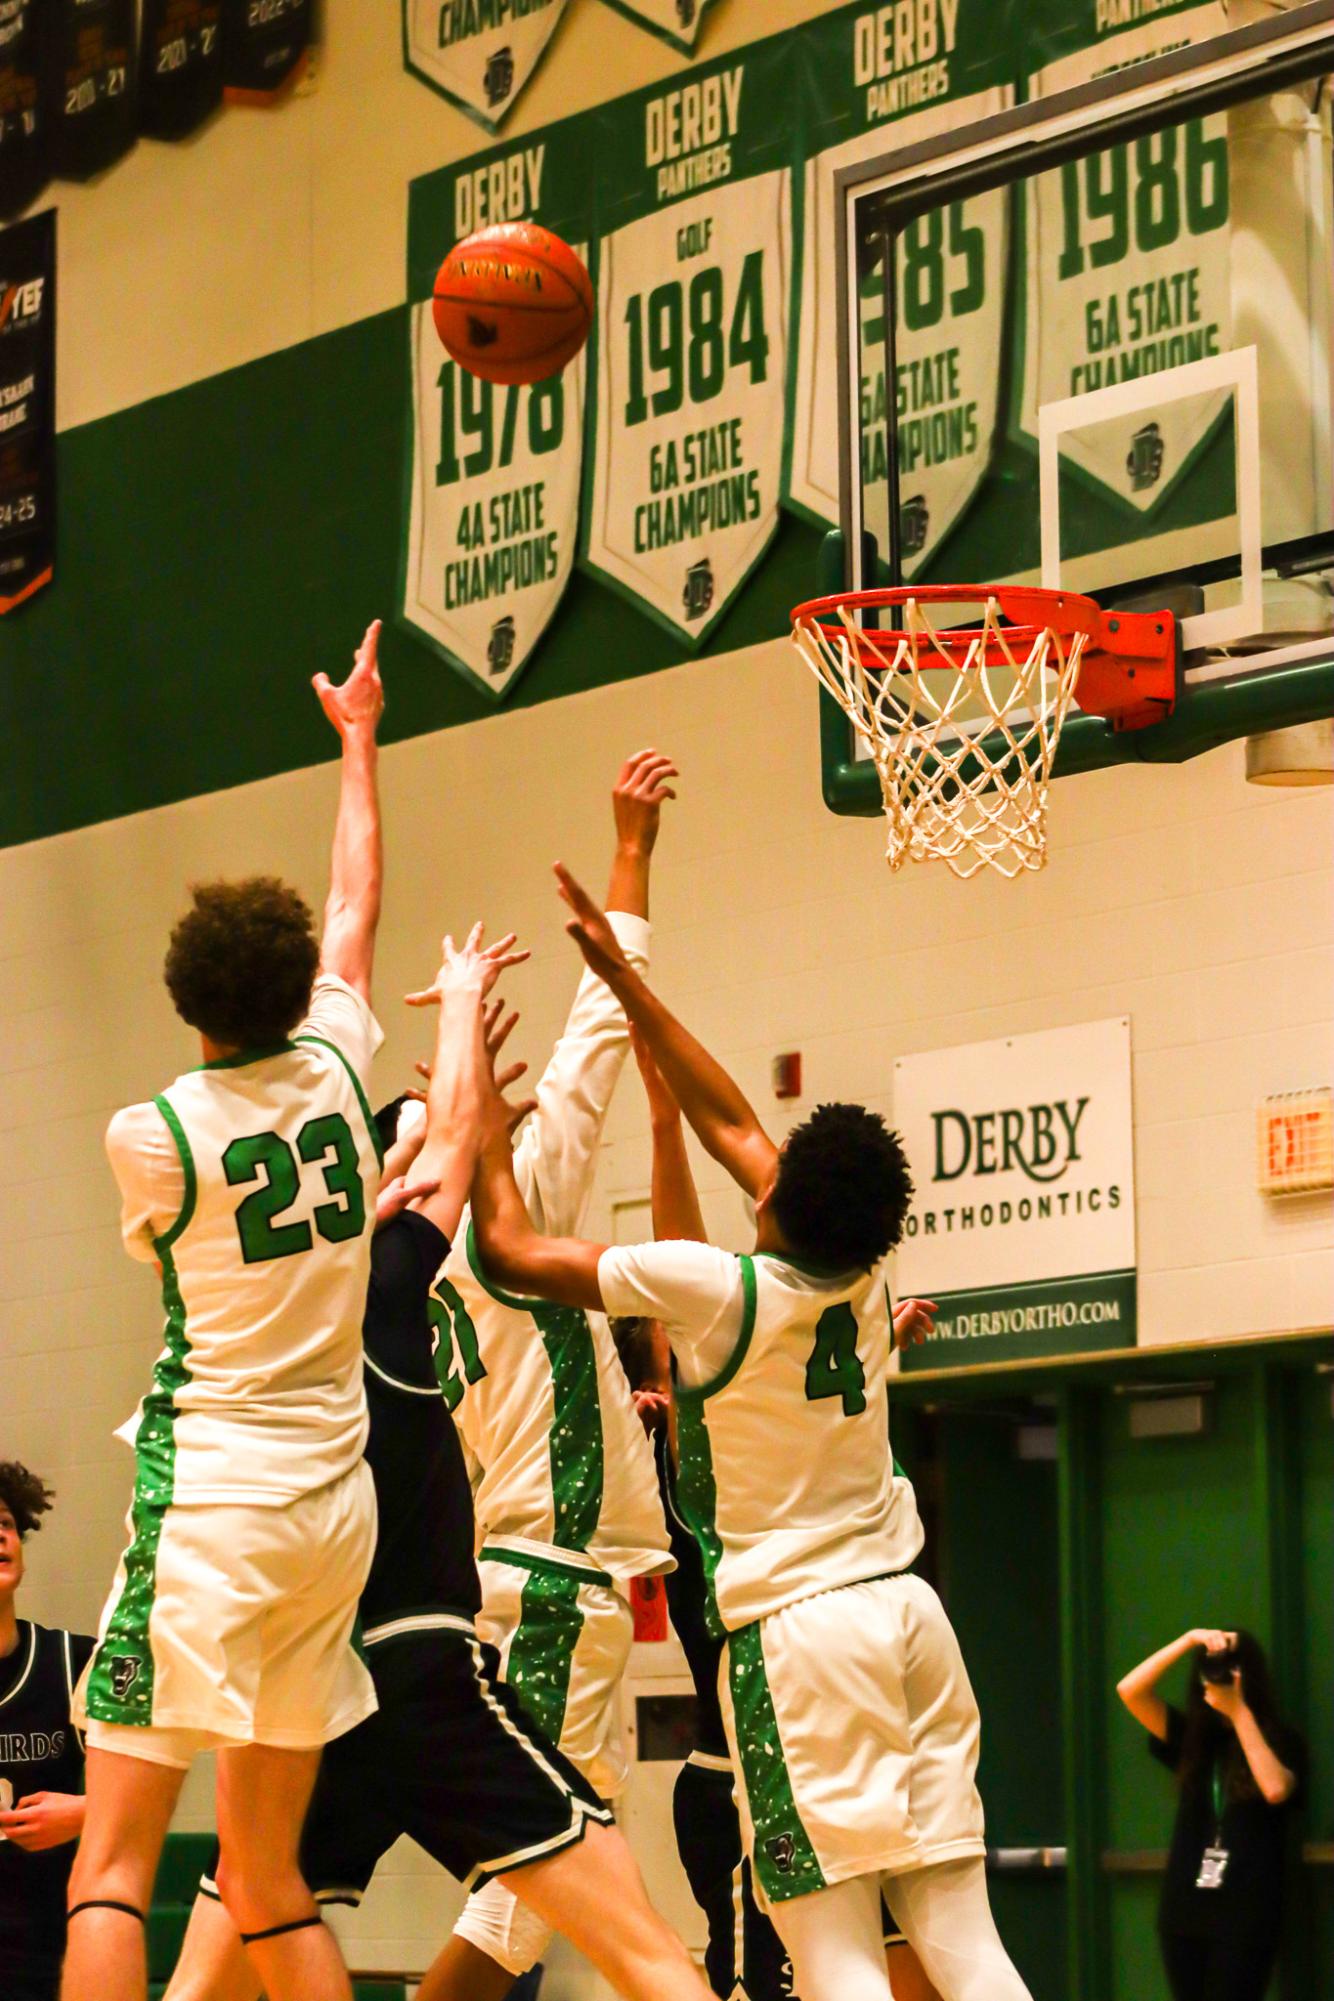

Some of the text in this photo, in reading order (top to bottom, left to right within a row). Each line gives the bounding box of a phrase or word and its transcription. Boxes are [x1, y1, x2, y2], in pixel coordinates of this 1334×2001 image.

[438, 0, 553, 49] CHAMP
[853, 0, 959, 87] DERBY
[1095, 0, 1184, 33] PANT
[645, 65, 744, 168] DERBY
[866, 59, 949, 122] PANTHERS
[455, 144, 546, 241] DERBY
[657, 143, 732, 201] PANTHERS
[1058, 117, 1230, 282] 1986
[676, 217, 714, 262] GOLF
[861, 200, 985, 347] 85
[623, 249, 770, 427] 1984
[1086, 267, 1201, 355] 6A STATE
[896, 347, 960, 417] STATE
[1071, 323, 1220, 398] CHAMPIONS
[650, 418, 743, 494] 6A STATE
[862, 401, 977, 484] HAPIONS
[457, 482, 546, 552] 4A STATE
[634, 470, 761, 554] CHAMPIONS
[444, 531, 559, 611] CHAMPIONS
[221, 1112, 367, 1265] 23
[905, 1185, 1122, 1238] ORTHODONTICS
[805, 1300, 867, 1417] 4
